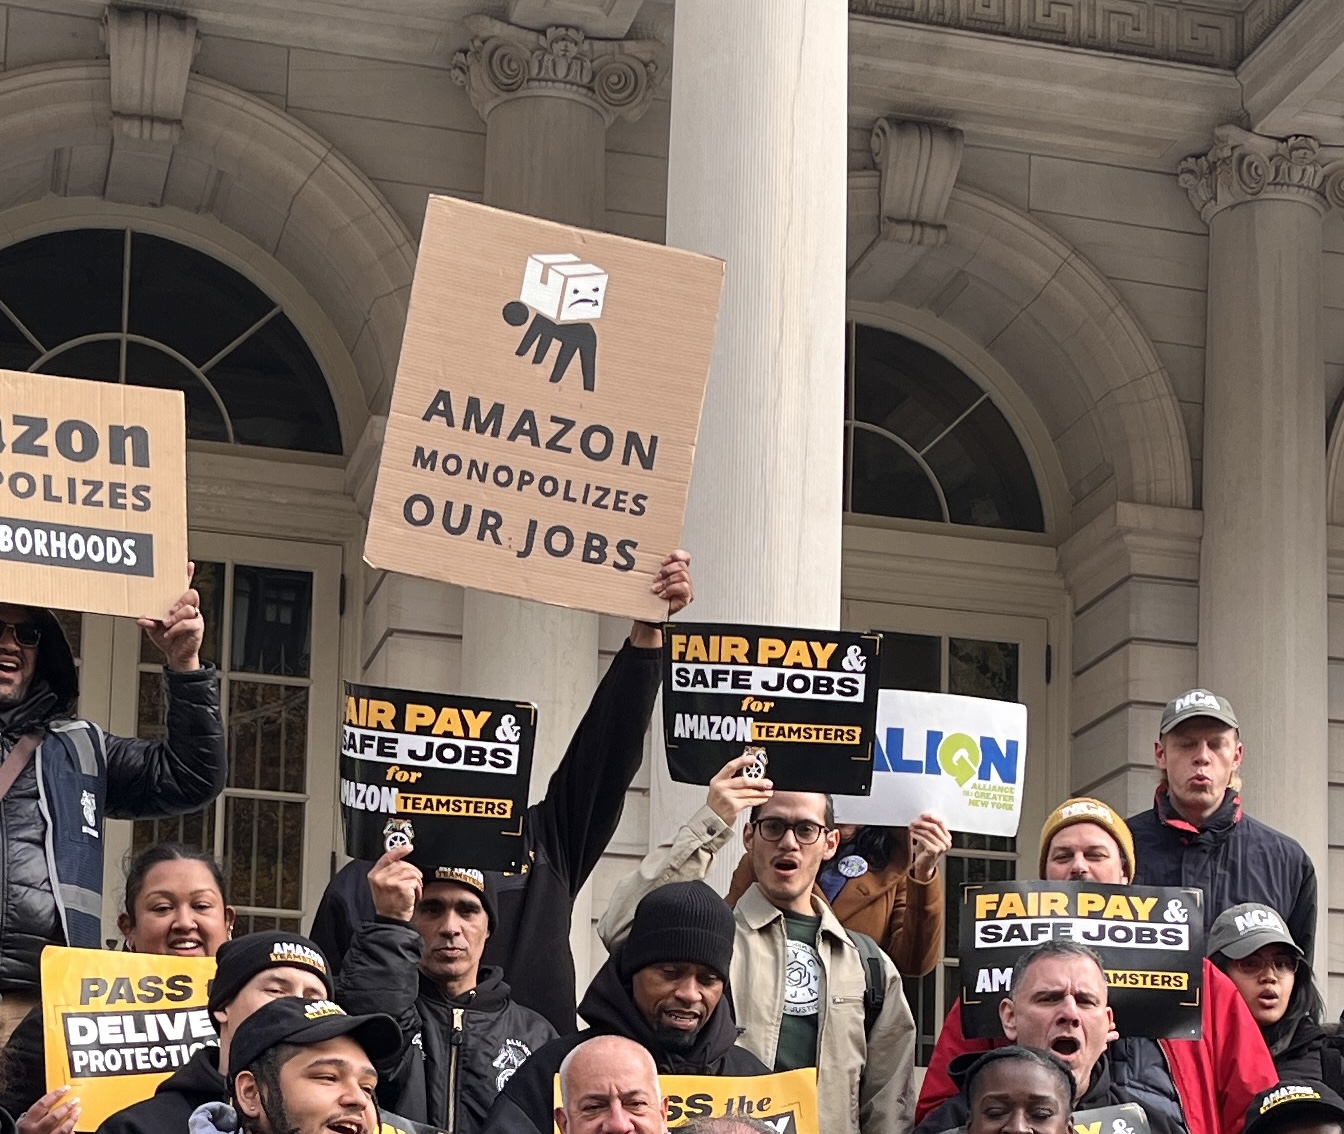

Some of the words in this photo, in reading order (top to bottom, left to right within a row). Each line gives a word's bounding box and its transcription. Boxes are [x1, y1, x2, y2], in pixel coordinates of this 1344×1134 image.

[422, 389, 659, 471] AMAZON
[412, 445, 648, 517] MONOPOLIZES
[403, 493, 503, 547] OUR
[516, 518, 639, 573] JOBS
[671, 634, 749, 664] FAIR
[757, 637, 839, 669] PAY
[841, 645, 867, 672] &
[674, 667, 752, 690] SAFE
[760, 670, 861, 698] JOBS
[741, 696, 775, 713] for
[1175, 691, 1221, 714] NCA
[345, 696, 396, 732] AIR
[404, 702, 492, 739] PAY
[495, 714, 521, 743] &
[673, 713, 753, 742] AMAZON
[755, 724, 858, 742] TEAMSTERS
[407, 741, 513, 769] JOBS
[385, 765, 423, 784] for
[971, 783, 1016, 794] ALLIANCE
[400, 794, 508, 816] TEAMSTERS
[975, 892, 1070, 920] FAIR
[1077, 892, 1159, 922] PAY
[1163, 899, 1188, 923] &
[1233, 909, 1284, 933] NCA
[980, 922, 1074, 944] SAFE
[1082, 923, 1184, 946] JOBS
[80, 974, 193, 1005] PASS
[1104, 972, 1184, 988] AMSTERS
[67, 1009, 216, 1045] DELIVE
[72, 1037, 221, 1073] PROTECTI
[668, 1093, 714, 1122] SS
[723, 1094, 773, 1116] the
